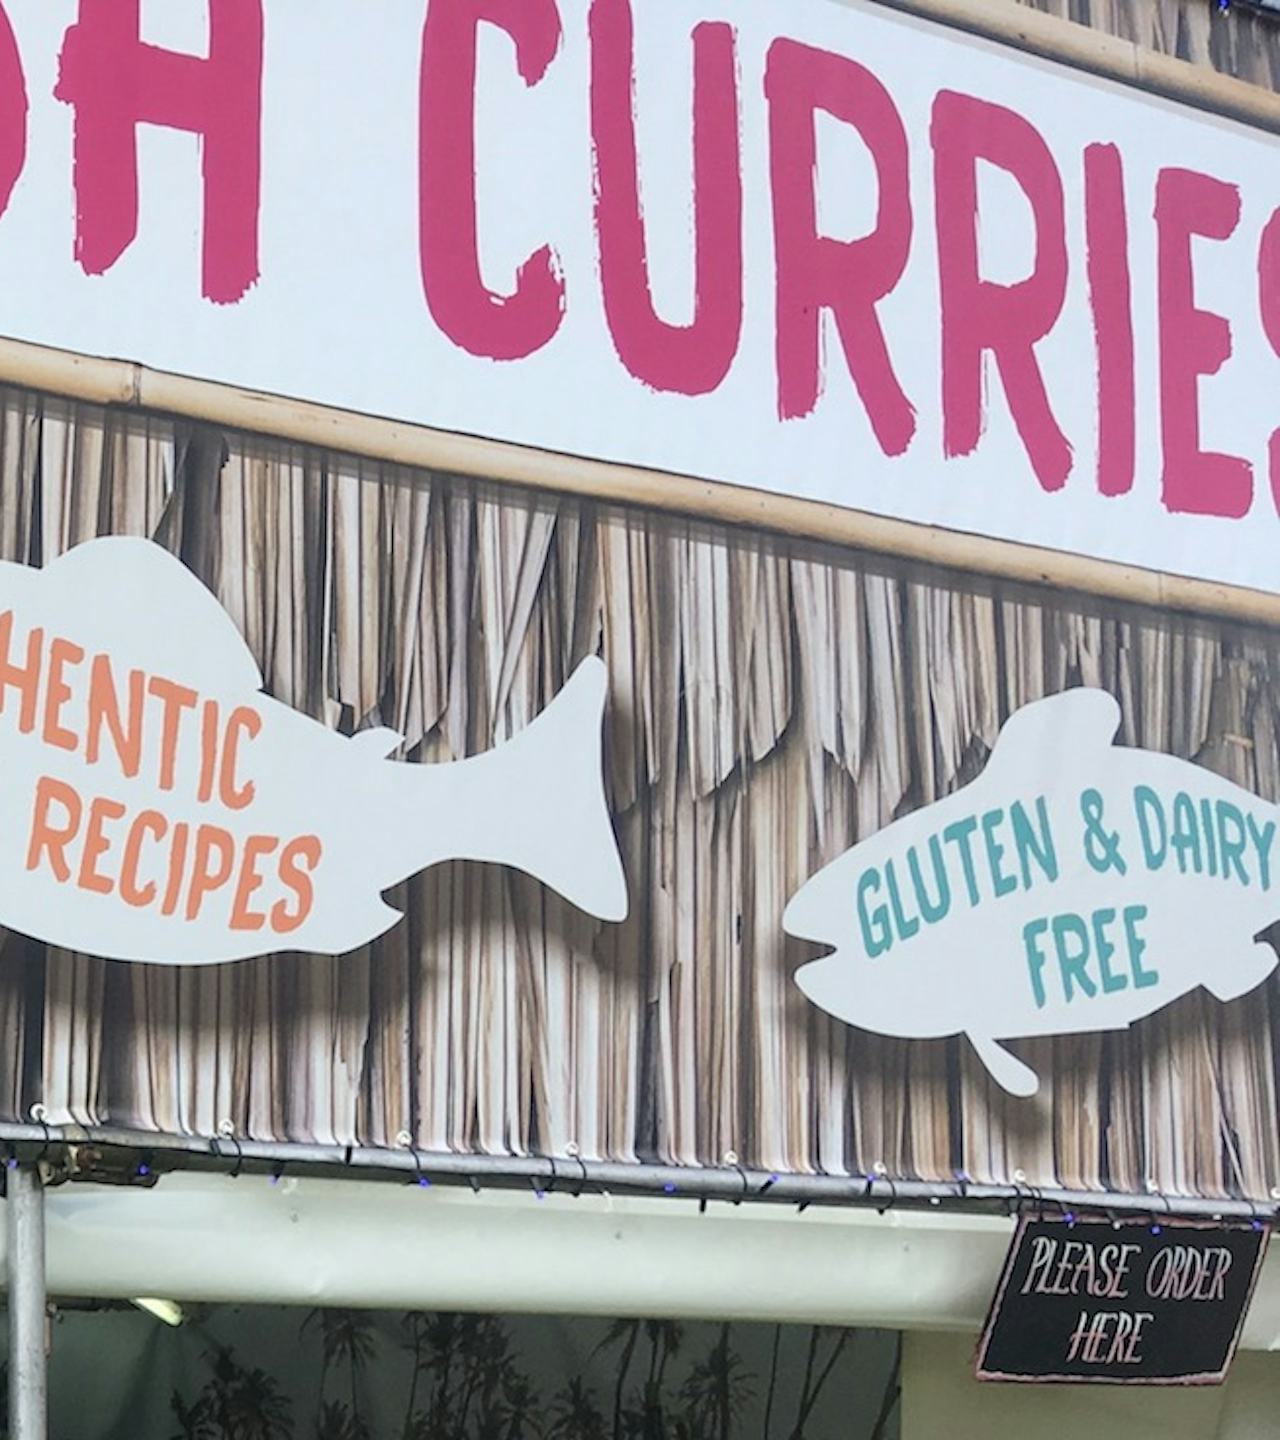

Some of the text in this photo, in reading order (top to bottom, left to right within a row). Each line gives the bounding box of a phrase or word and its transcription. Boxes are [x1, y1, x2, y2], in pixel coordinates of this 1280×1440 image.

[419, 0, 1280, 522] CURRIE
[26, 776, 322, 934] RECIPES
[855, 785, 1277, 959] GLUTEN & DAIRY
[1023, 905, 1159, 1009] FREE
[1021, 1236, 1232, 1300] PLEASE ORDER
[1066, 1311, 1154, 1363] HERE
